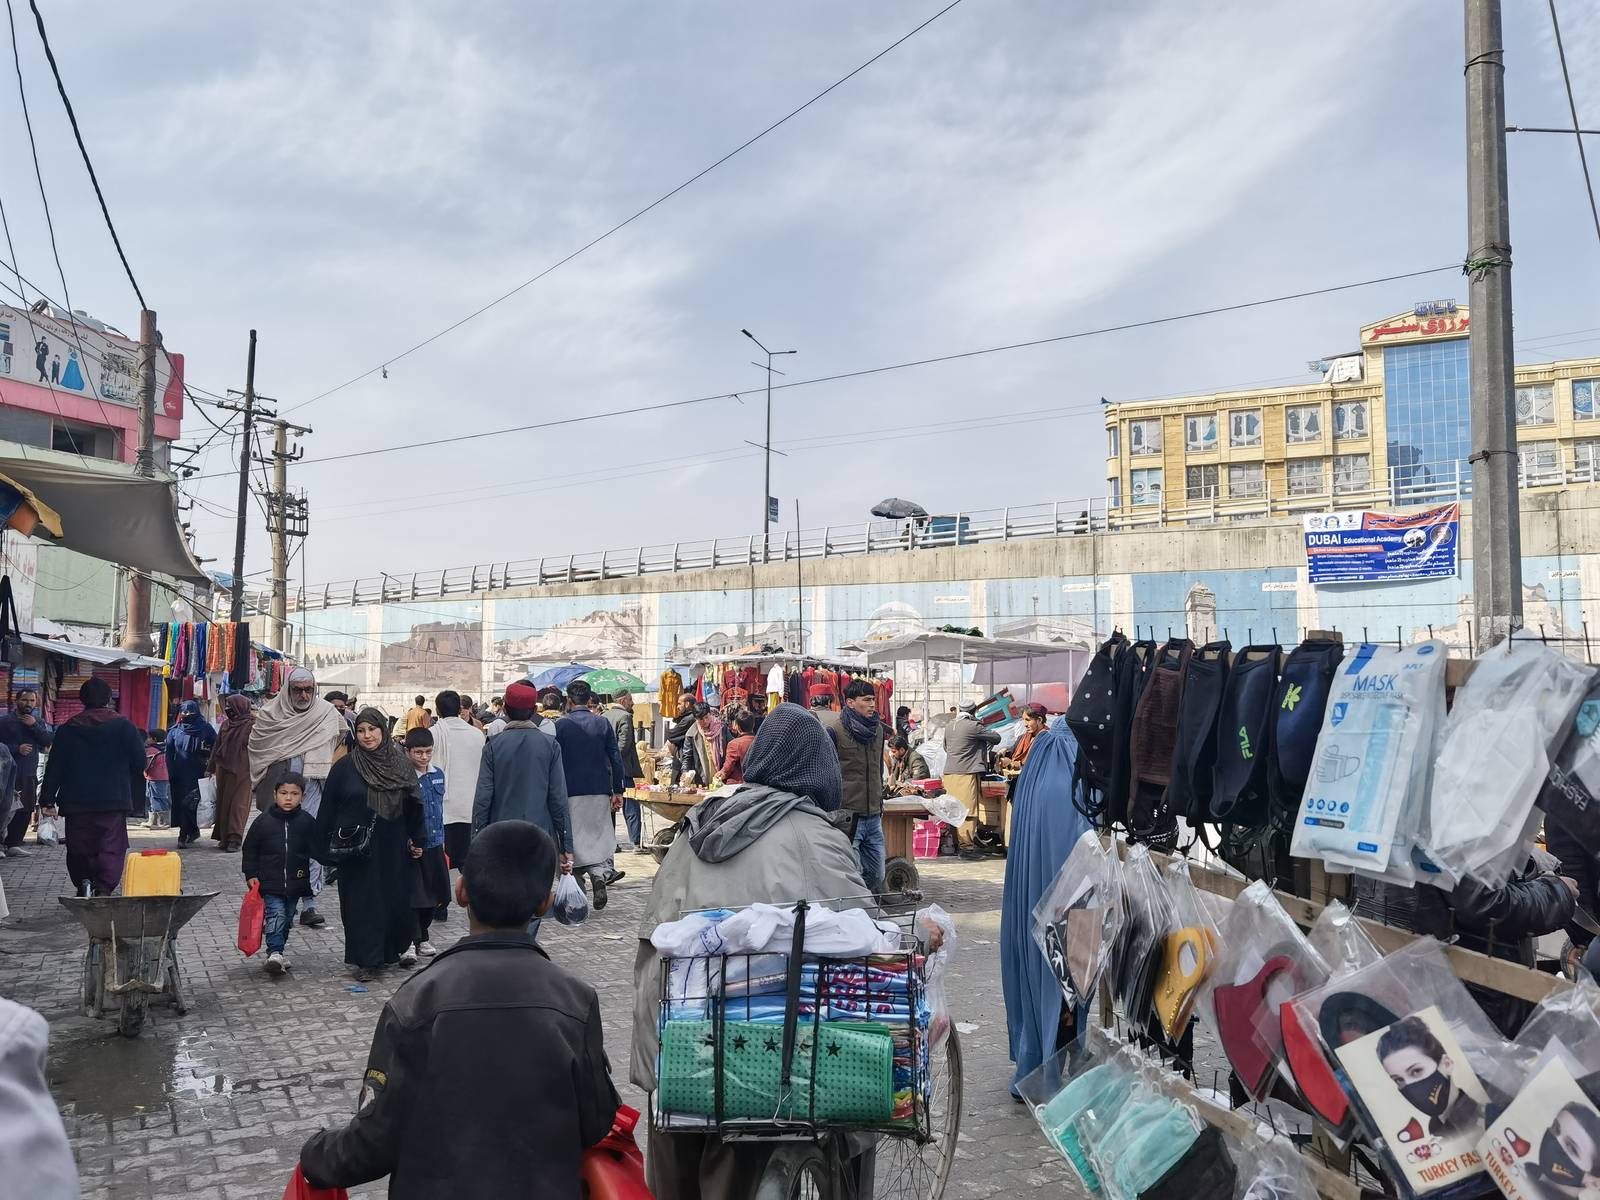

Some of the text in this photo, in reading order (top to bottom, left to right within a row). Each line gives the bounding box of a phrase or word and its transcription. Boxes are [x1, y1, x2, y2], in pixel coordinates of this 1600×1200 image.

[1369, 319, 1420, 341] سنتر
[1308, 533, 1403, 546] DUBAI Educational Academy
[1353, 674, 1399, 691] MASK
[1238, 726, 1254, 760] FILA
[1417, 1156, 1460, 1183] TURKEY
[1485, 1151, 1517, 1195] TURKEY
